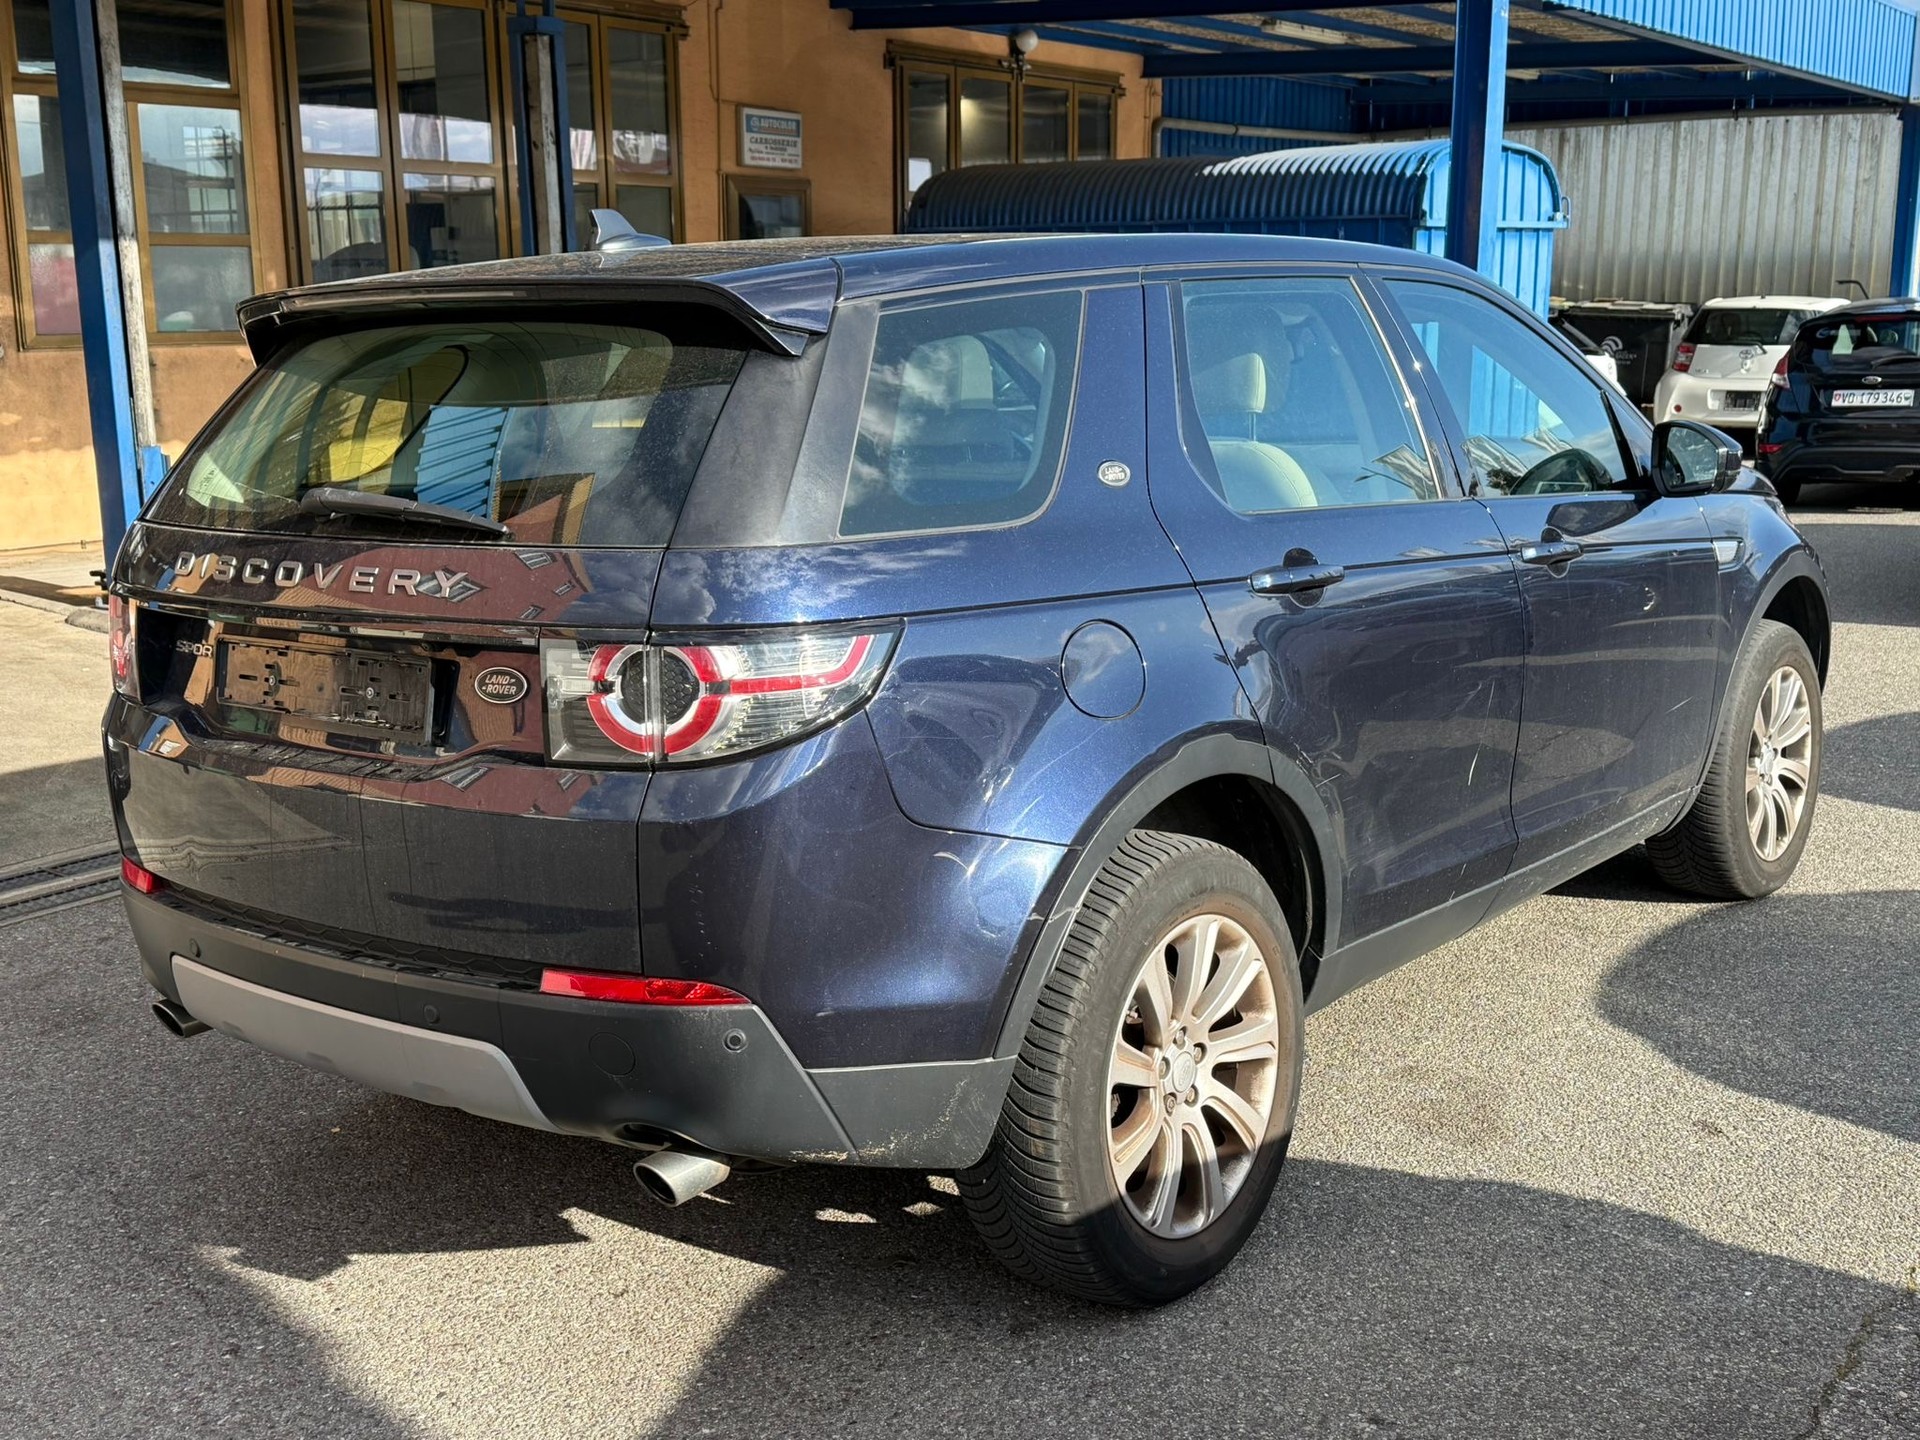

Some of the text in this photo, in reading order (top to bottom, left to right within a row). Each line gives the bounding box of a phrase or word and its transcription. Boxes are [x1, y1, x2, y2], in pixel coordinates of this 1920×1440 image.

[760, 118, 797, 129] AUTOCOLOR
[750, 136, 798, 147] CARROSSERIE
[173, 551, 468, 598] DISCOVERY
[175, 639, 213, 658] SPOR
[485, 674, 510, 685] LAND
[486, 684, 517, 695] ROVER
